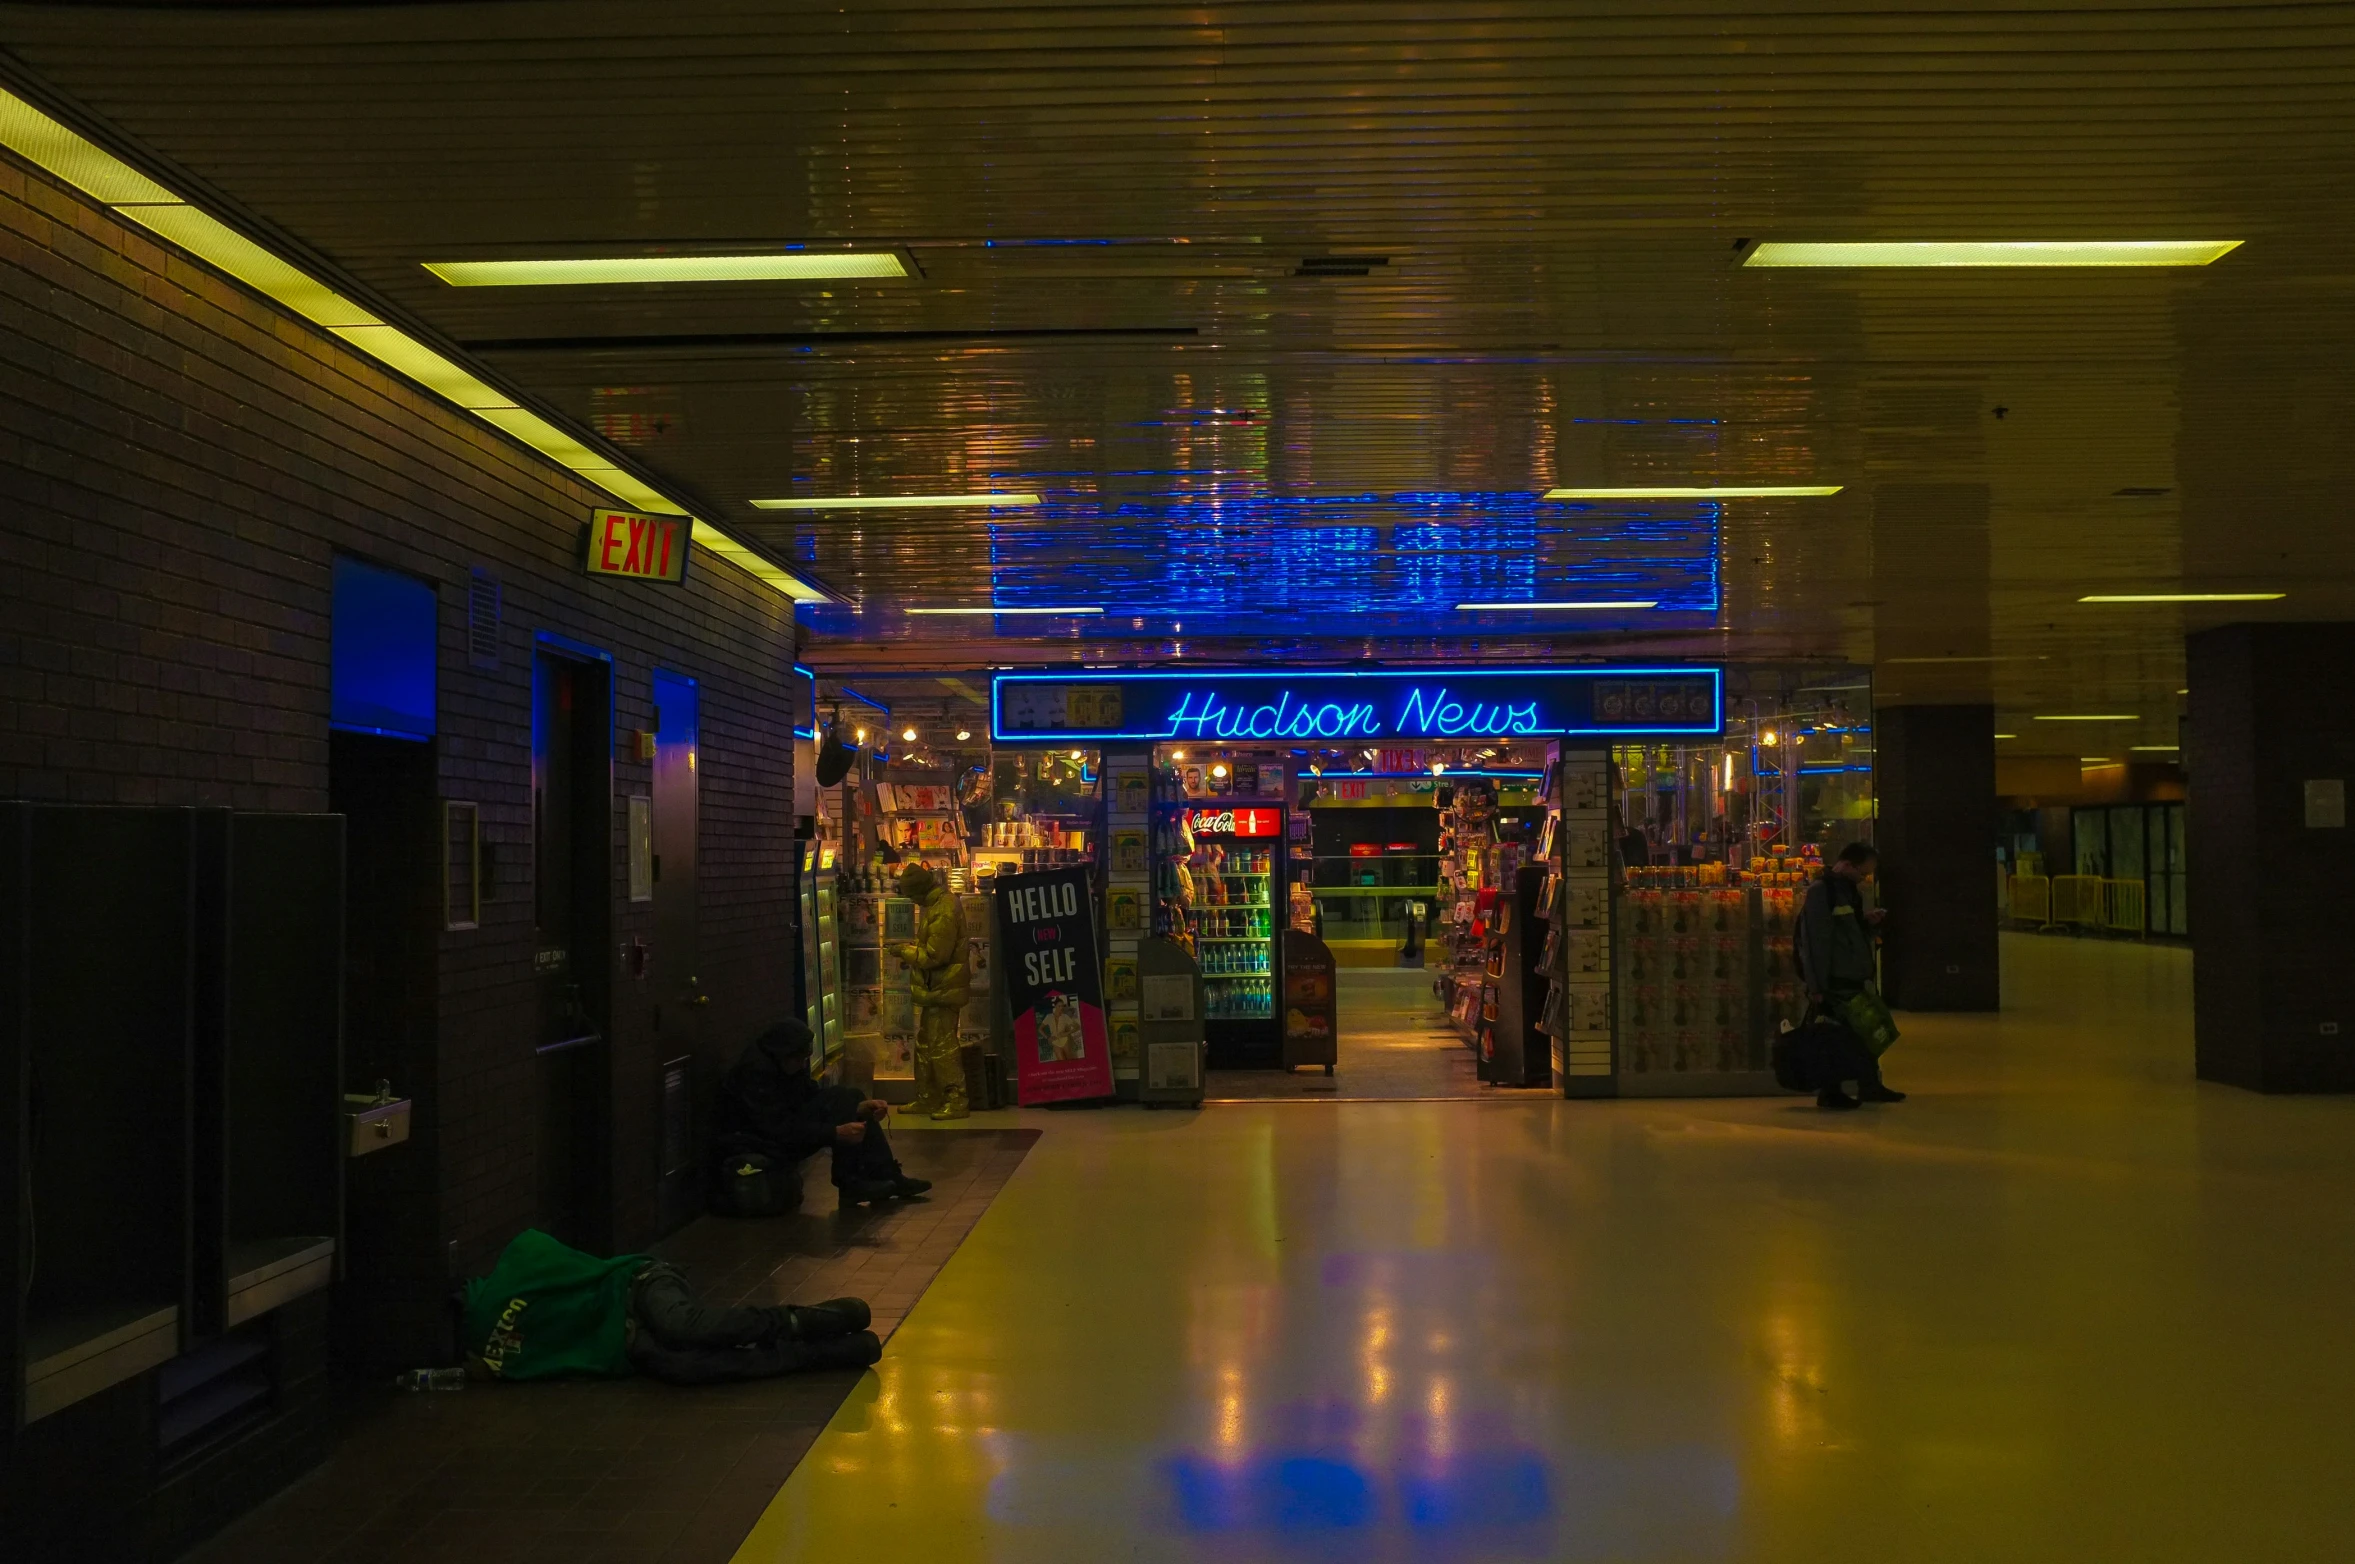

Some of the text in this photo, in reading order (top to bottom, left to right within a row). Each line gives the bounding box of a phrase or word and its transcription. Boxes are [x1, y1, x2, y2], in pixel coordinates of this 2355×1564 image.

[601, 515, 679, 577] EXIT
[1167, 687, 1538, 737] Hudson News
[1342, 781, 1366, 798] EXIT
[1008, 882, 1078, 923] HELLO
[1024, 947, 1076, 986] SELF
